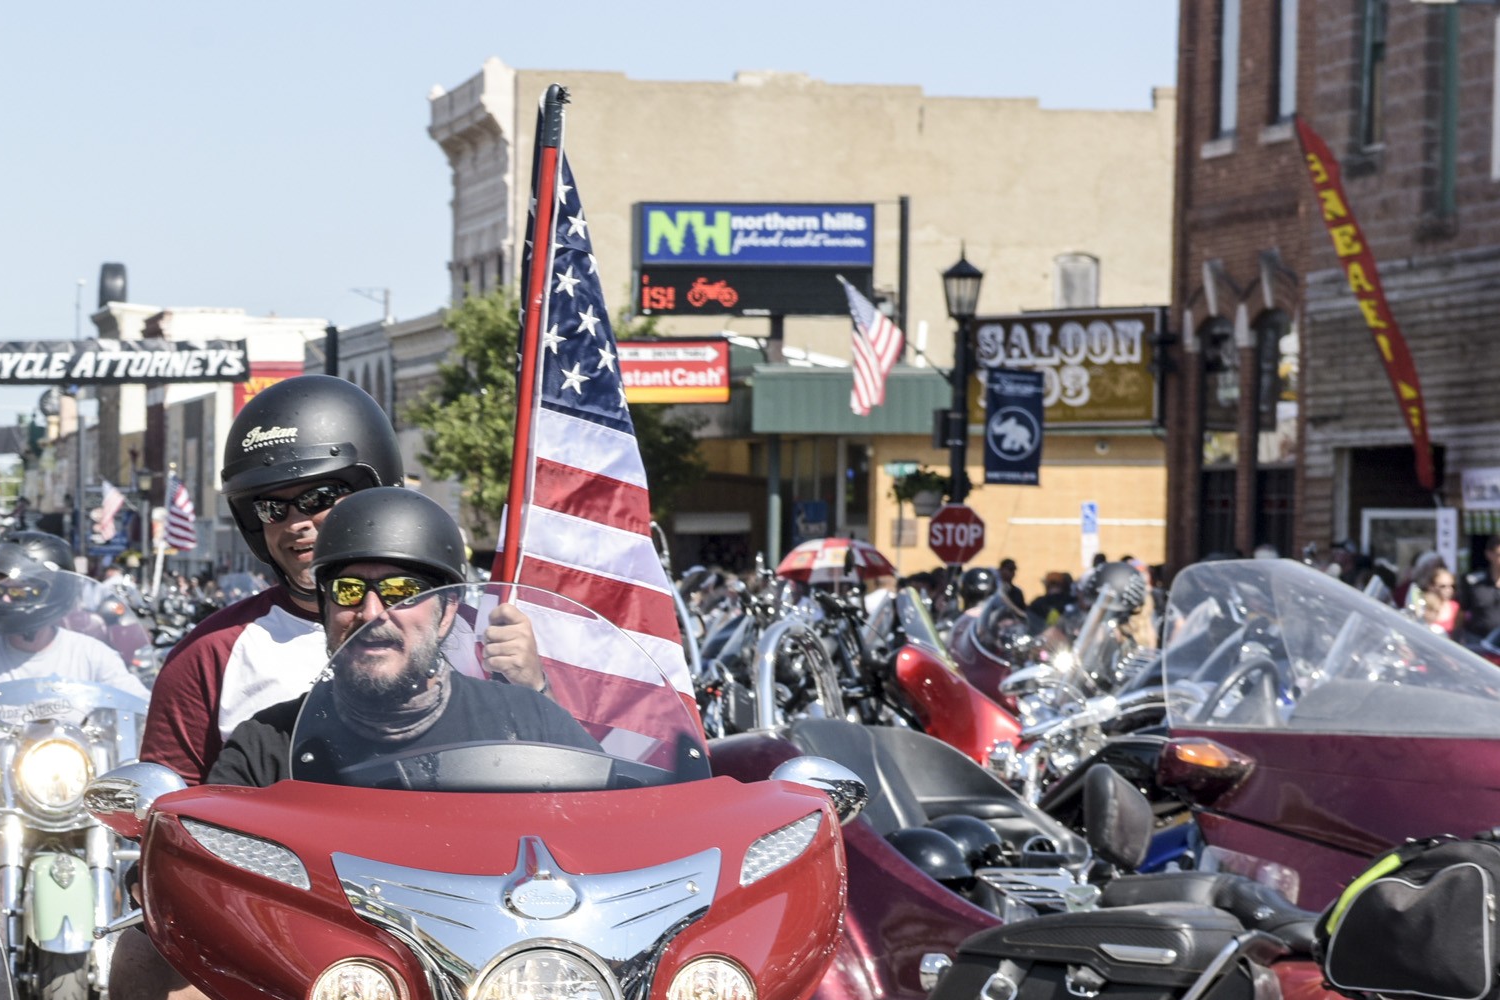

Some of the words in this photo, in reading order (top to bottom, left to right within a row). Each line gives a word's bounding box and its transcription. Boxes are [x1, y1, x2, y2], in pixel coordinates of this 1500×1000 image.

[731, 212, 820, 231] northern
[822, 212, 866, 231] hills
[976, 319, 1145, 367] SALOON
[71, 349, 245, 379] ATTORNEYS
[242, 426, 298, 448] Indian
[930, 523, 983, 547] STOP
